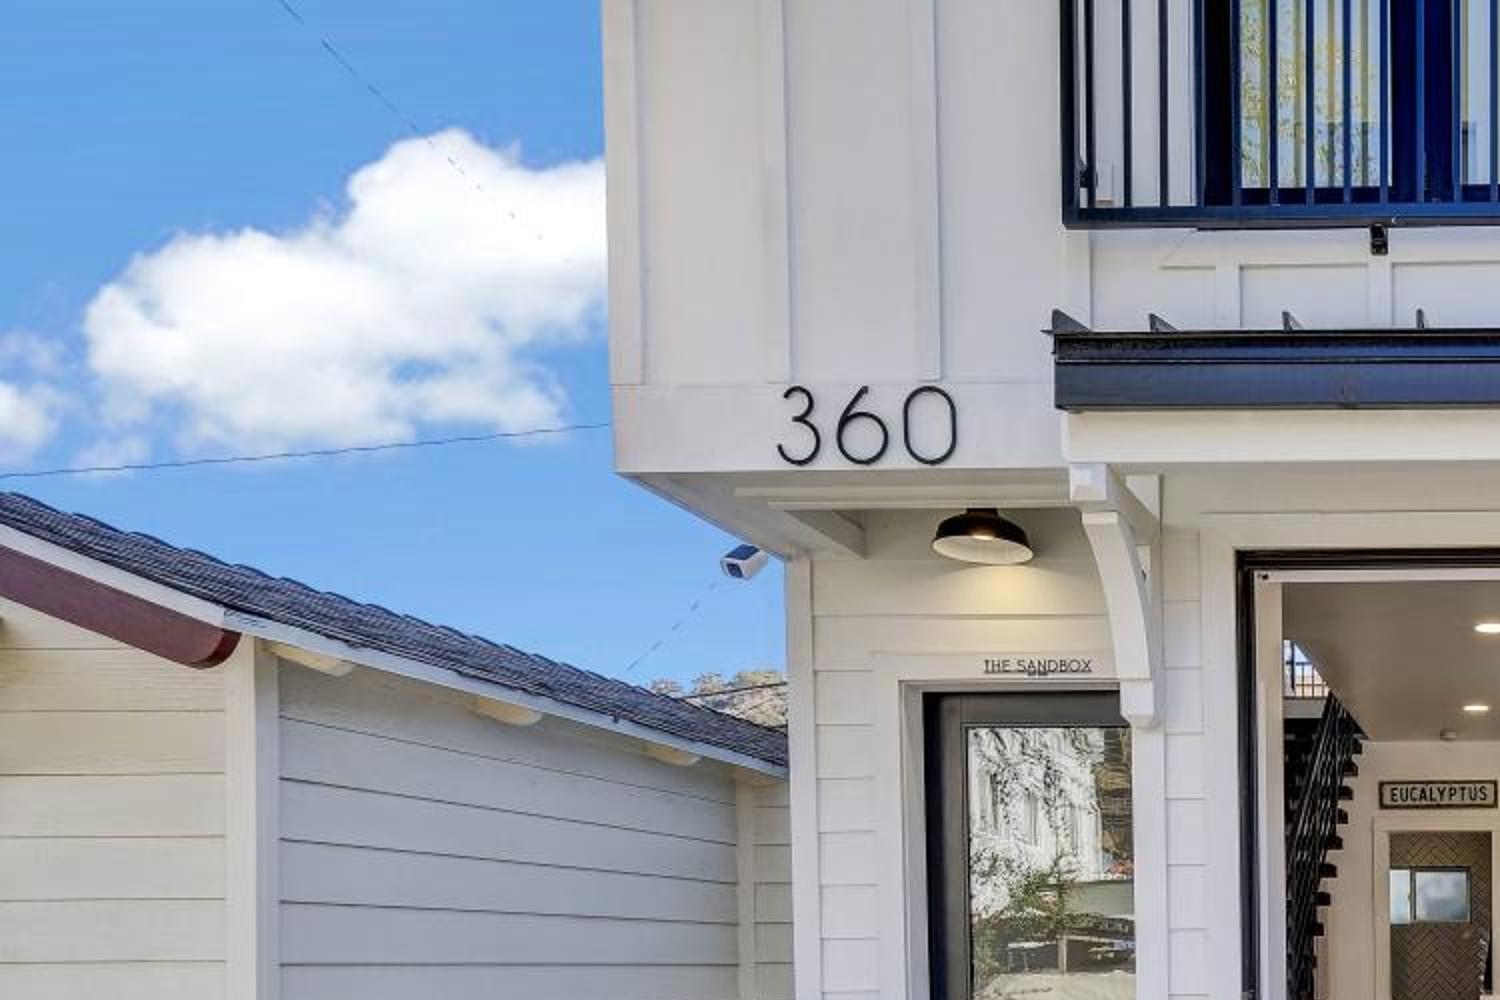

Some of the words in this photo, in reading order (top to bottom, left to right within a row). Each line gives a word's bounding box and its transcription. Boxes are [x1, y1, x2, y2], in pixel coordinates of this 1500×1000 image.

[777, 385, 957, 466] 360
[983, 659, 1010, 673] THE
[1017, 659, 1093, 675] SANDBOX
[1390, 785, 1488, 802] EUCALYPTUS
